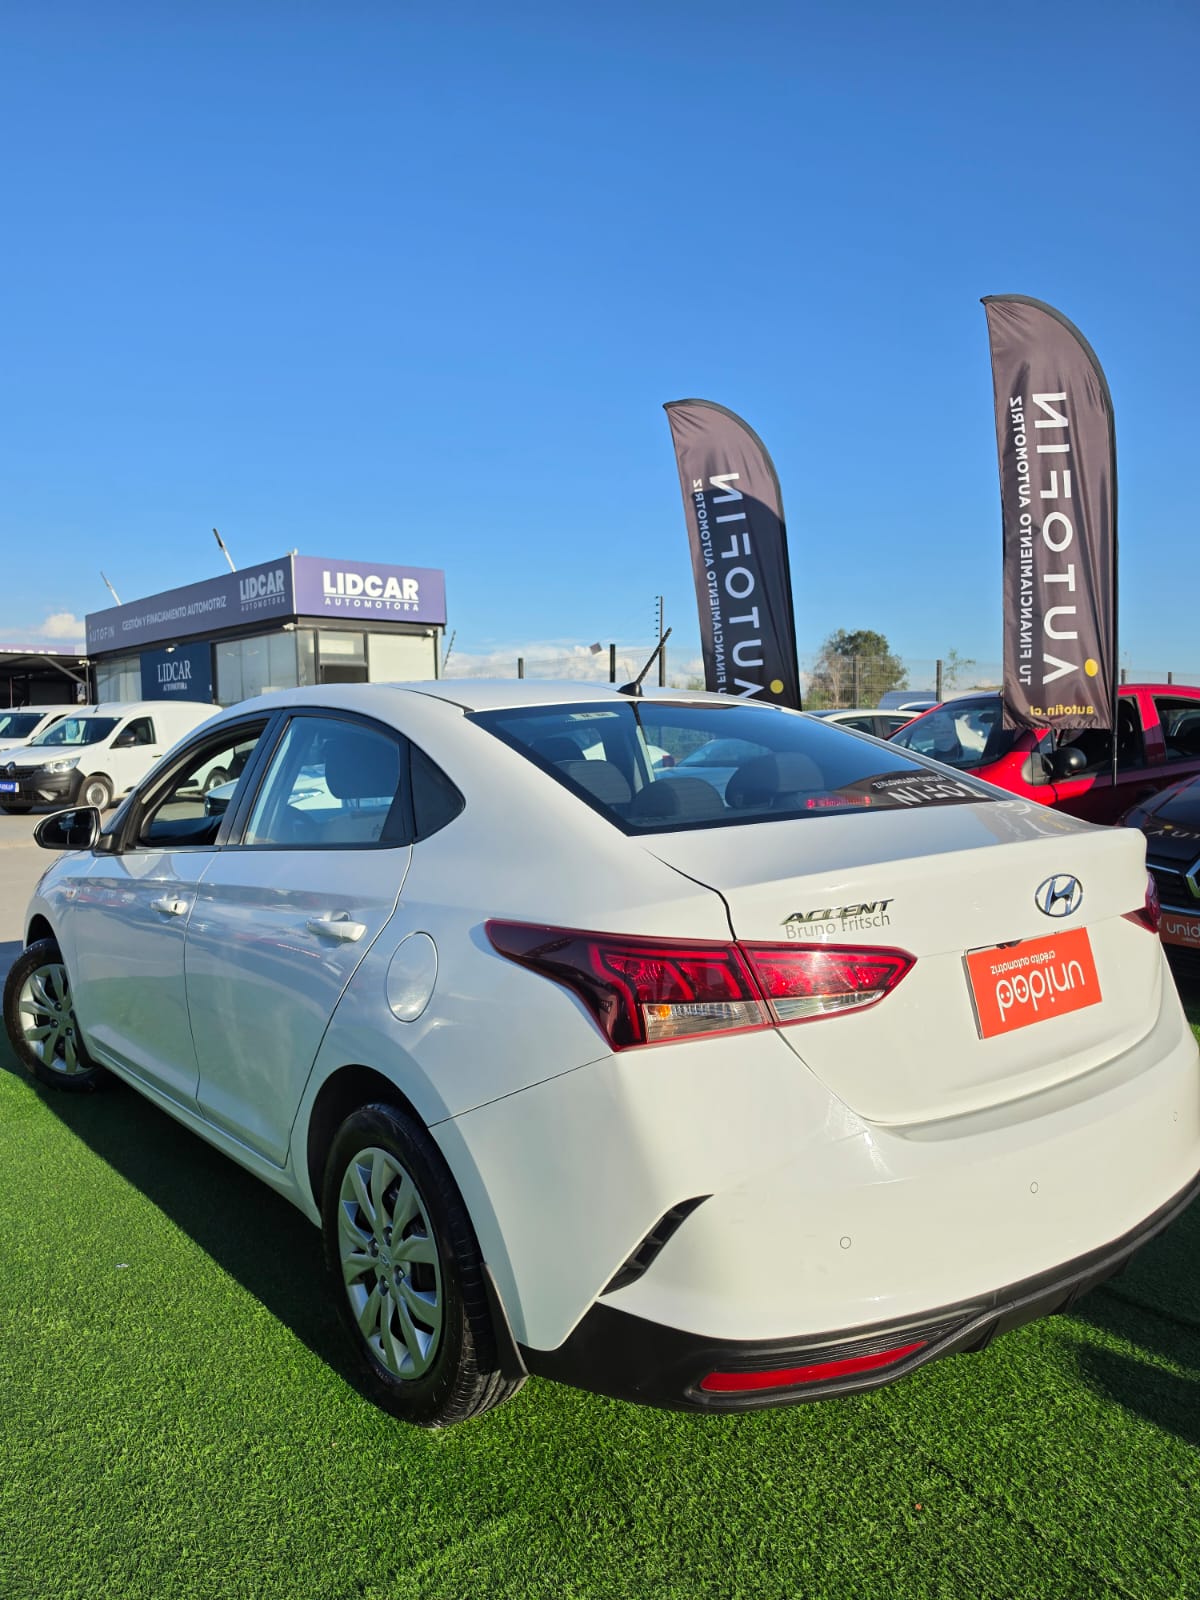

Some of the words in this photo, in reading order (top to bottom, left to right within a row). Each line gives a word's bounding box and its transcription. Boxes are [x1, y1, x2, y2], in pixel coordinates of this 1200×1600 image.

[240, 569, 285, 600] LIDCAR
[323, 571, 419, 600] LIDCAR
[122, 615, 142, 631] GESTIÓN
[187, 595, 227, 615] AUTOMOTRIZ
[241, 596, 285, 611] AUTOMOTORA
[325, 597, 419, 611] AUTOMOTORA
[89, 626, 115, 642] AUTOFIN
[157, 660, 192, 682] LIDCAR
[780, 899, 894, 925] ACCENT
[786, 923, 836, 939] Bruno
[841, 912, 890, 932] Fritsch
[990, 956, 1029, 975] automotriz
[1031, 950, 1056, 965] crédito
[996, 960, 1086, 1022] unidad
